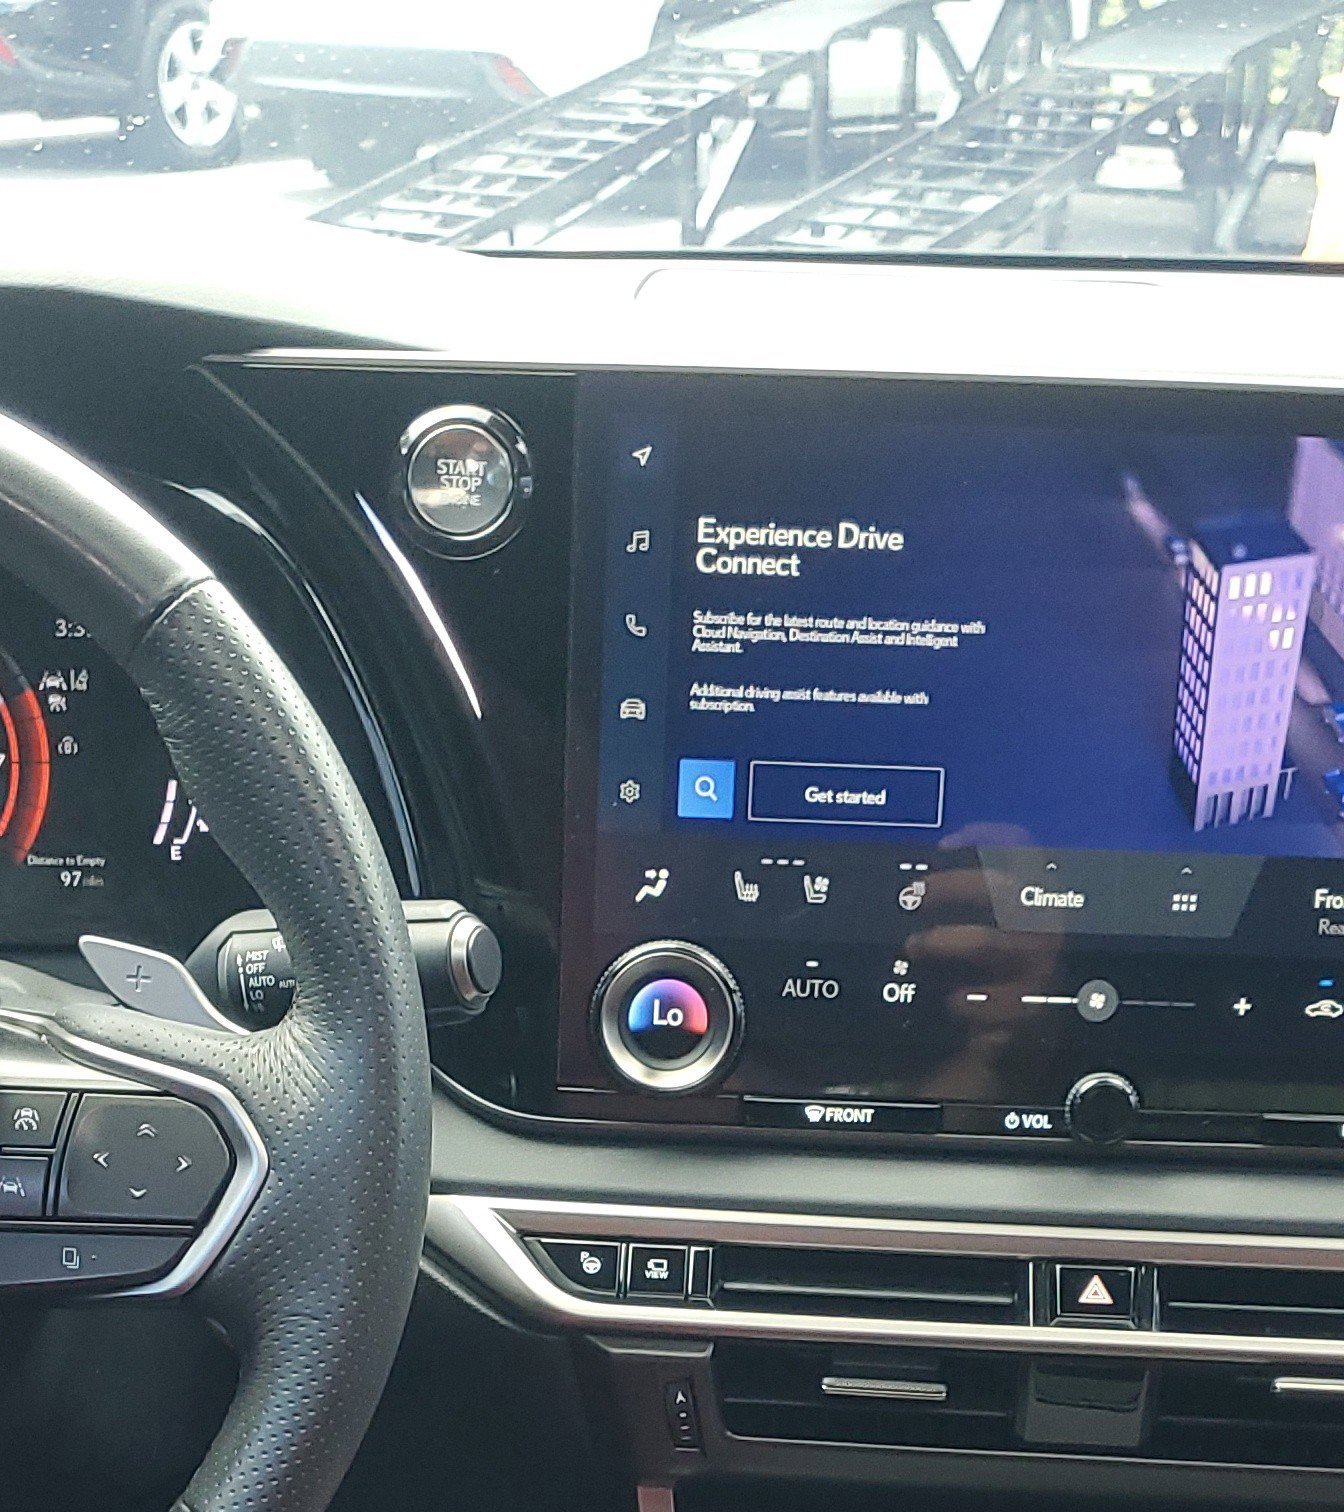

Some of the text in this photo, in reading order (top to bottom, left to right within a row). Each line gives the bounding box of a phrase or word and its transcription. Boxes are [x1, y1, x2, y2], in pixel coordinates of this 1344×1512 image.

[436, 459, 488, 476] START
[440, 476, 482, 492] STOP
[697, 516, 904, 551] Experience Drive
[696, 547, 801, 577] Connect
[693, 610, 986, 634] Subscribe for the latest route and location guidance with
[692, 625, 727, 638] Cloud
[788, 627, 851, 643] Destination
[851, 630, 884, 645] Assist
[883, 632, 905, 645] and
[689, 683, 744, 697] Additional
[744, 685, 781, 702] driving
[812, 687, 857, 702] features
[903, 691, 930, 705] with
[804, 786, 887, 805] Get started
[170, 845, 182, 861] E
[60, 870, 82, 887] 97
[1020, 886, 1085, 909] Climate
[246, 950, 270, 962] MIST
[245, 962, 267, 975] OFF
[248, 975, 276, 989] AUTO
[782, 979, 839, 999] AUTO
[882, 982, 916, 1004] Off
[652, 999, 684, 1027] Lo
[825, 1108, 875, 1124] FRONT
[1022, 1114, 1053, 1129] VOL
[645, 1270, 669, 1279] VIEW
